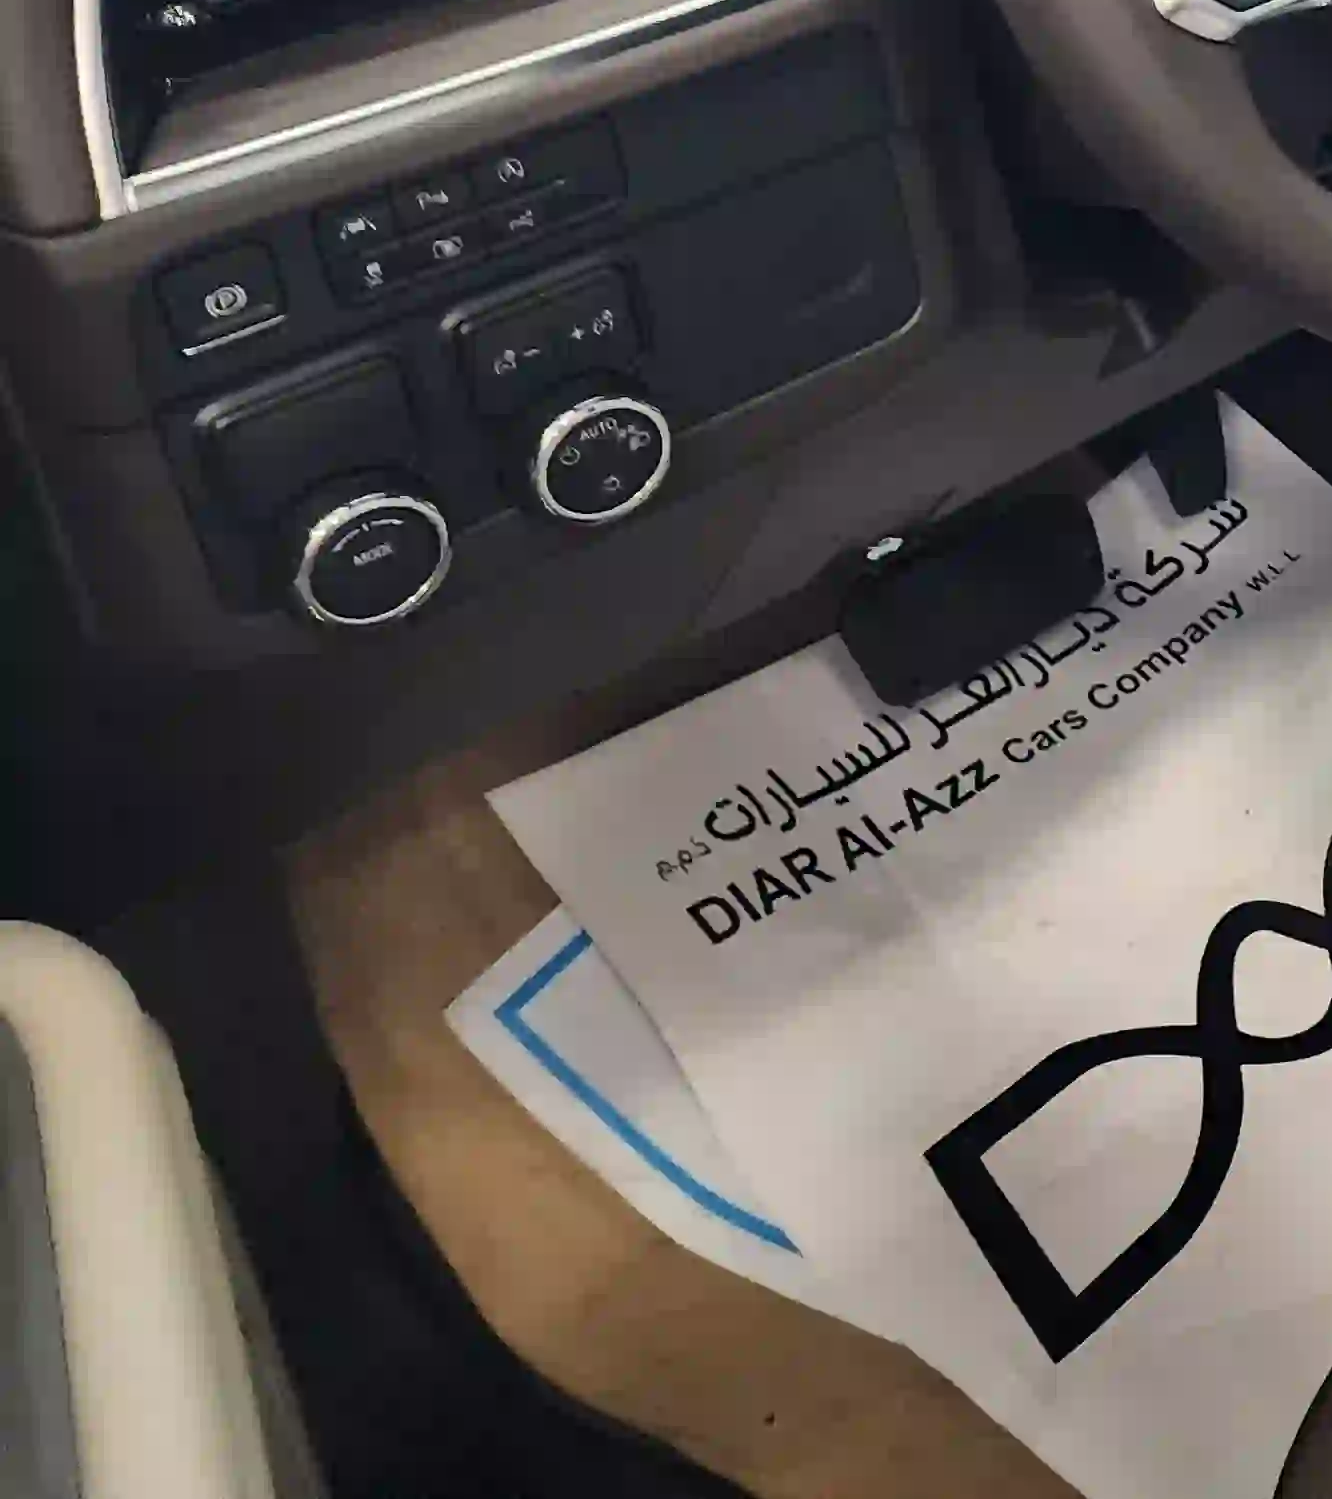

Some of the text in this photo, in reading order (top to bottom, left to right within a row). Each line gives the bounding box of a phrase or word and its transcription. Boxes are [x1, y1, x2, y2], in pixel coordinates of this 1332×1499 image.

[1107, 498, 1248, 608] شركة
[685, 847, 837, 945] DIAR
[835, 758, 1001, 872] Al-Azz
[1001, 709, 1089, 766] Cars
[1087, 590, 1245, 710] Company
[704, 712, 911, 841] للسيارات
